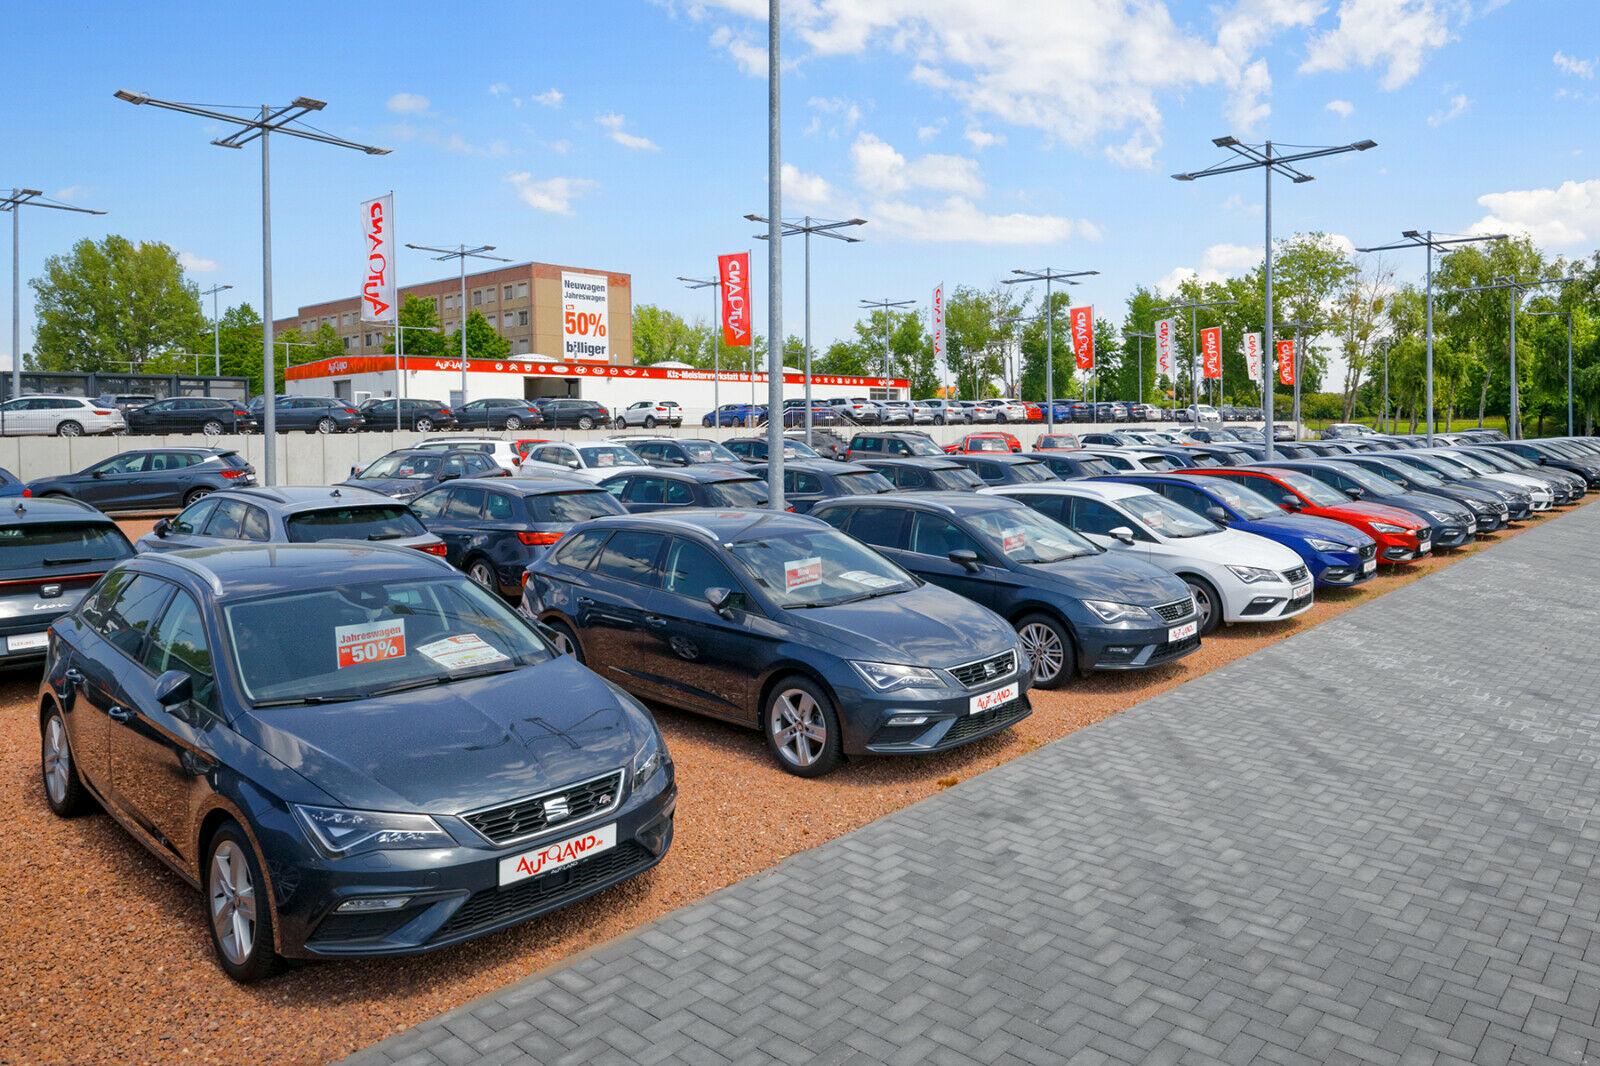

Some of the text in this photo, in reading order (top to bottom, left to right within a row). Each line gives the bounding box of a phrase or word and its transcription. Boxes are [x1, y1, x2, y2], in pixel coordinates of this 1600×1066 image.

[564, 280, 605, 292] Neuwagen
[564, 292, 605, 302] Jahreswagen
[565, 311, 606, 337] 50%
[566, 341, 606, 356] billiger
[666, 369, 738, 381] Kfz-Meisterwrkstatt
[340, 626, 401, 644] Jahreswagen
[352, 640, 398, 663] 50%
